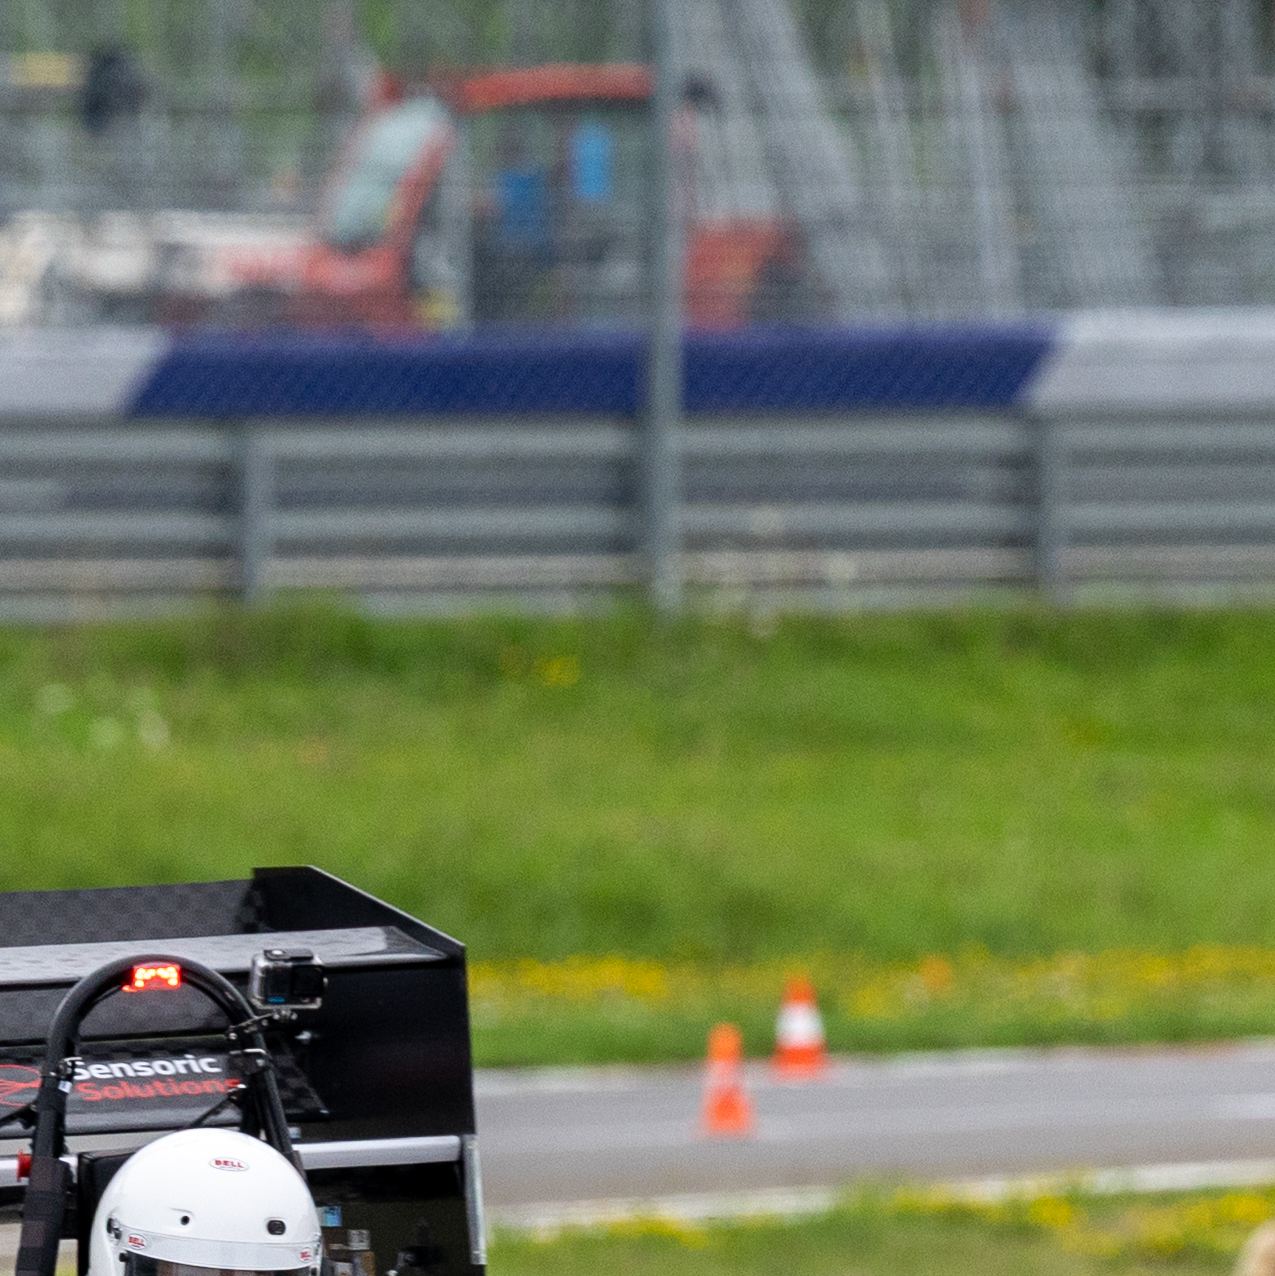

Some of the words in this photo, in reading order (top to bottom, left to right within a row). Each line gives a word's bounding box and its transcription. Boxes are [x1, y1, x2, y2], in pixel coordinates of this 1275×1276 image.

[67, 1054, 222, 1080] Sensoric
[214, 1158, 245, 1169] BELL
[128, 1235, 146, 1247] BELL
